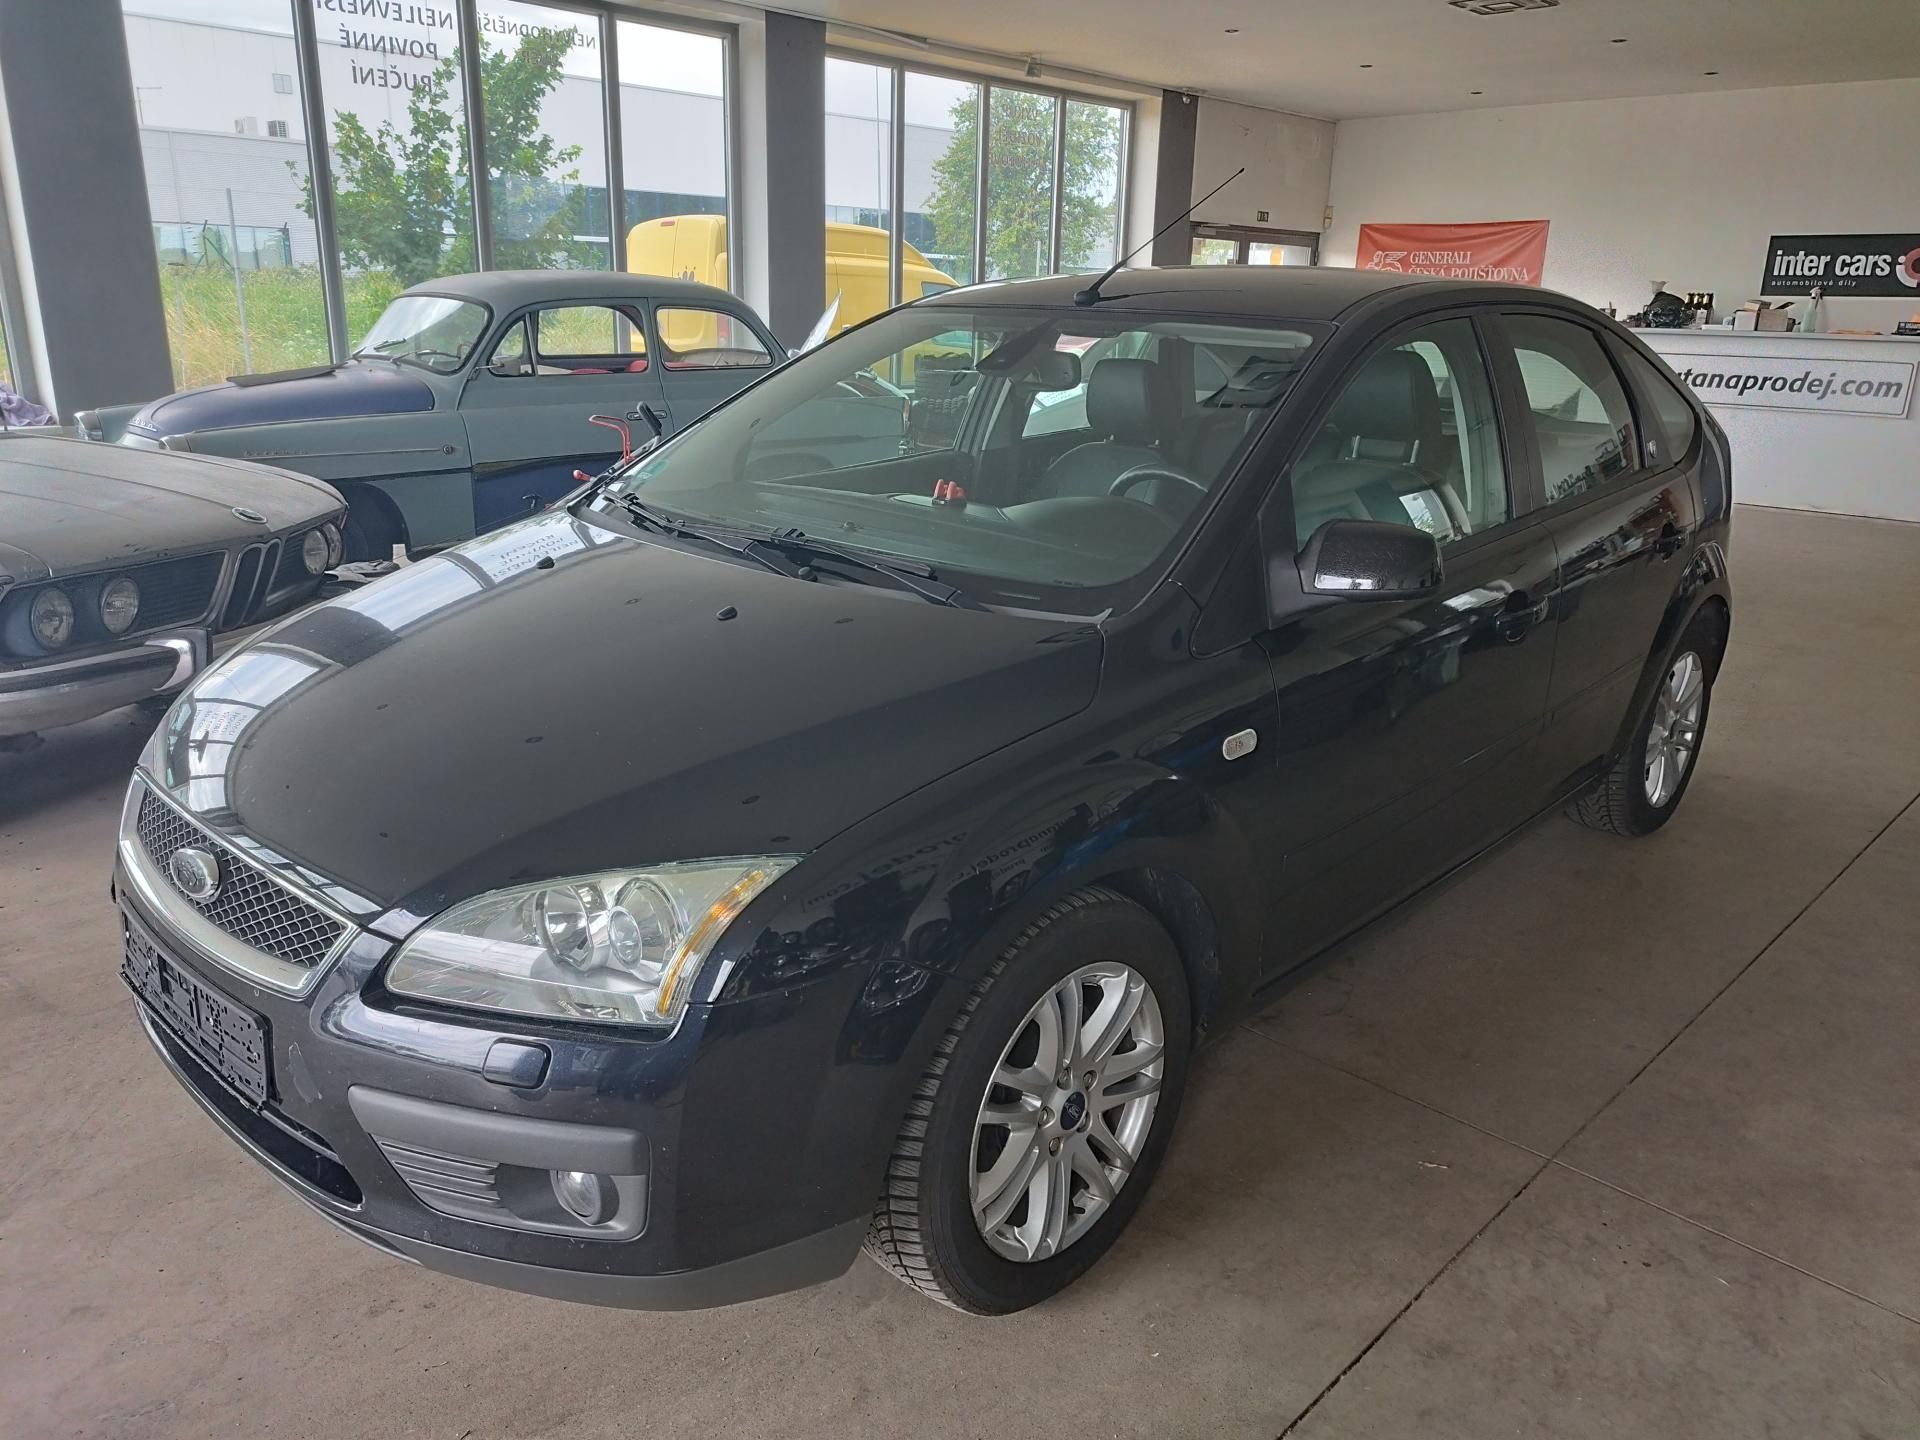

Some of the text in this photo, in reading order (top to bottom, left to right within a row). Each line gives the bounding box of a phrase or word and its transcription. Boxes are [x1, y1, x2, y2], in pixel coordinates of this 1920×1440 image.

[1410, 251, 1472, 265] GENERALI
[1773, 249, 1892, 277] inter cars
[1838, 280, 1857, 288] díly
[1678, 367, 1904, 400] tanaprodej.com
